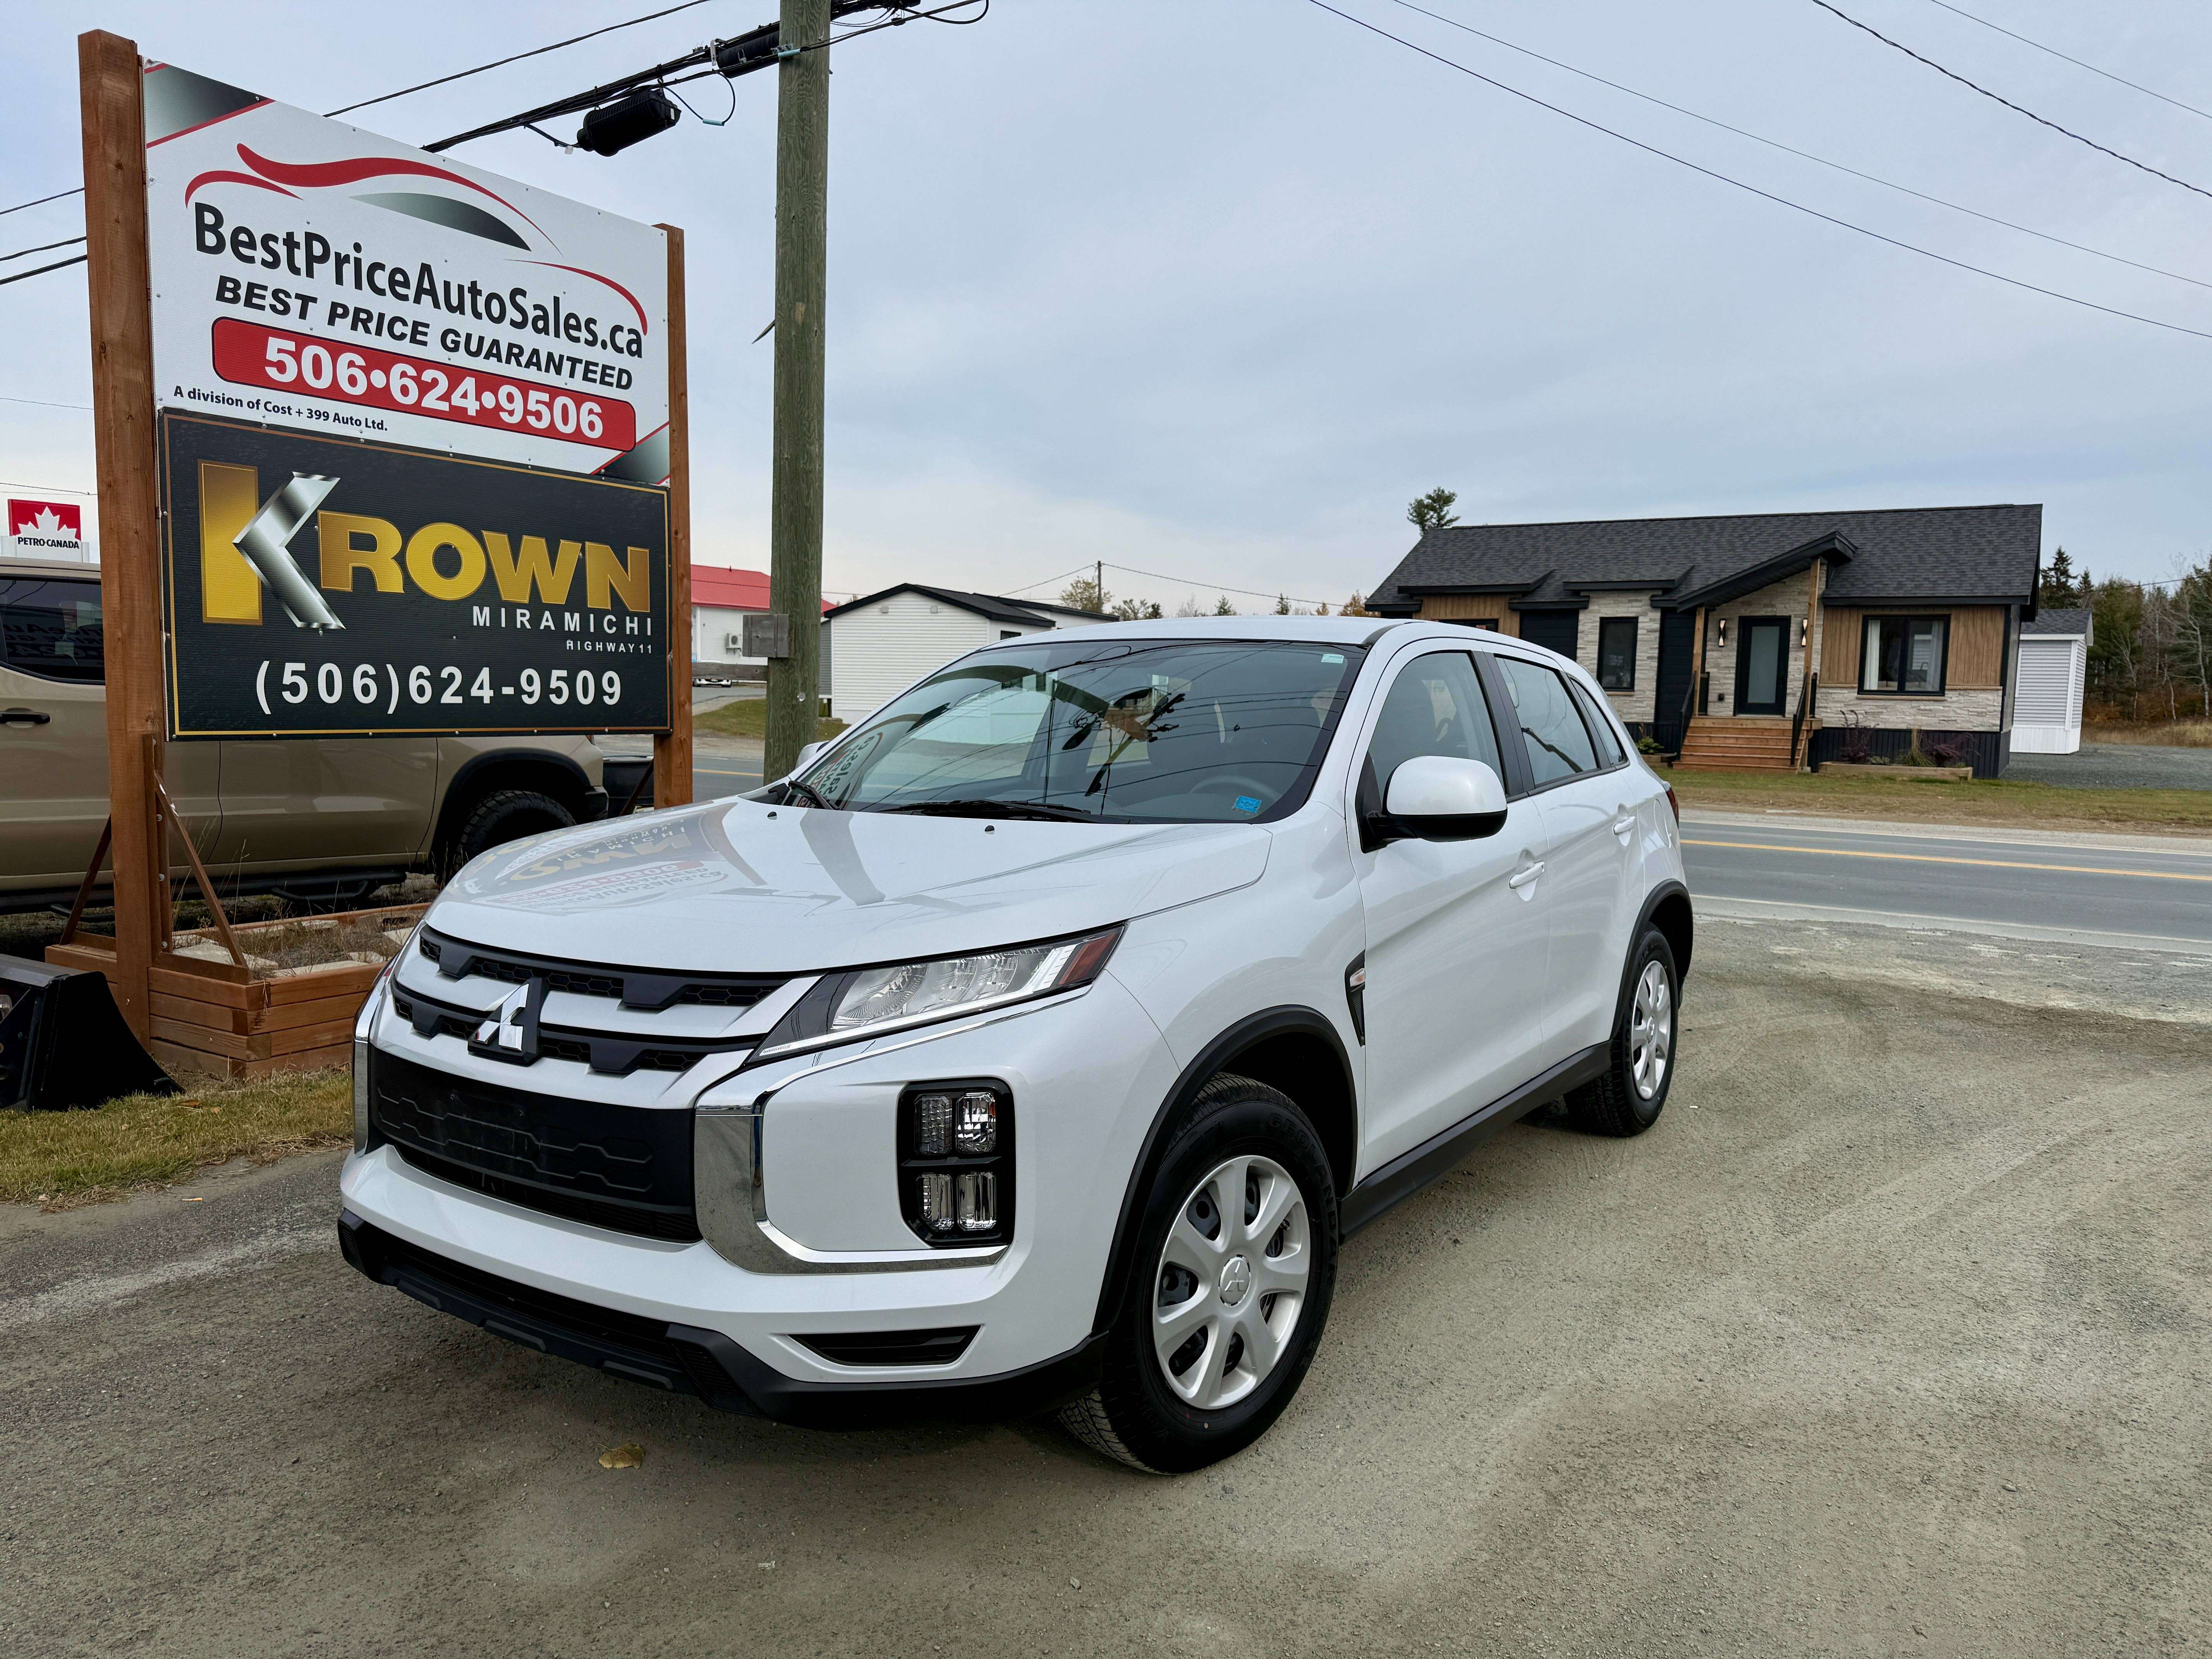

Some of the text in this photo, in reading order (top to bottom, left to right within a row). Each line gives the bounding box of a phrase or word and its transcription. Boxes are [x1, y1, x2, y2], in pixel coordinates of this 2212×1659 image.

[195, 202, 643, 359] BestPriceAutoSales.ca
[215, 275, 632, 390] BEST PRICE GUARANTEED
[174, 385, 388, 431] A division of Cost + 399 Auto Ltd.
[198, 459, 650, 629] KROWN
[473, 606, 652, 636] MIRAMICHI
[256, 661, 621, 715] (506)624-9509
